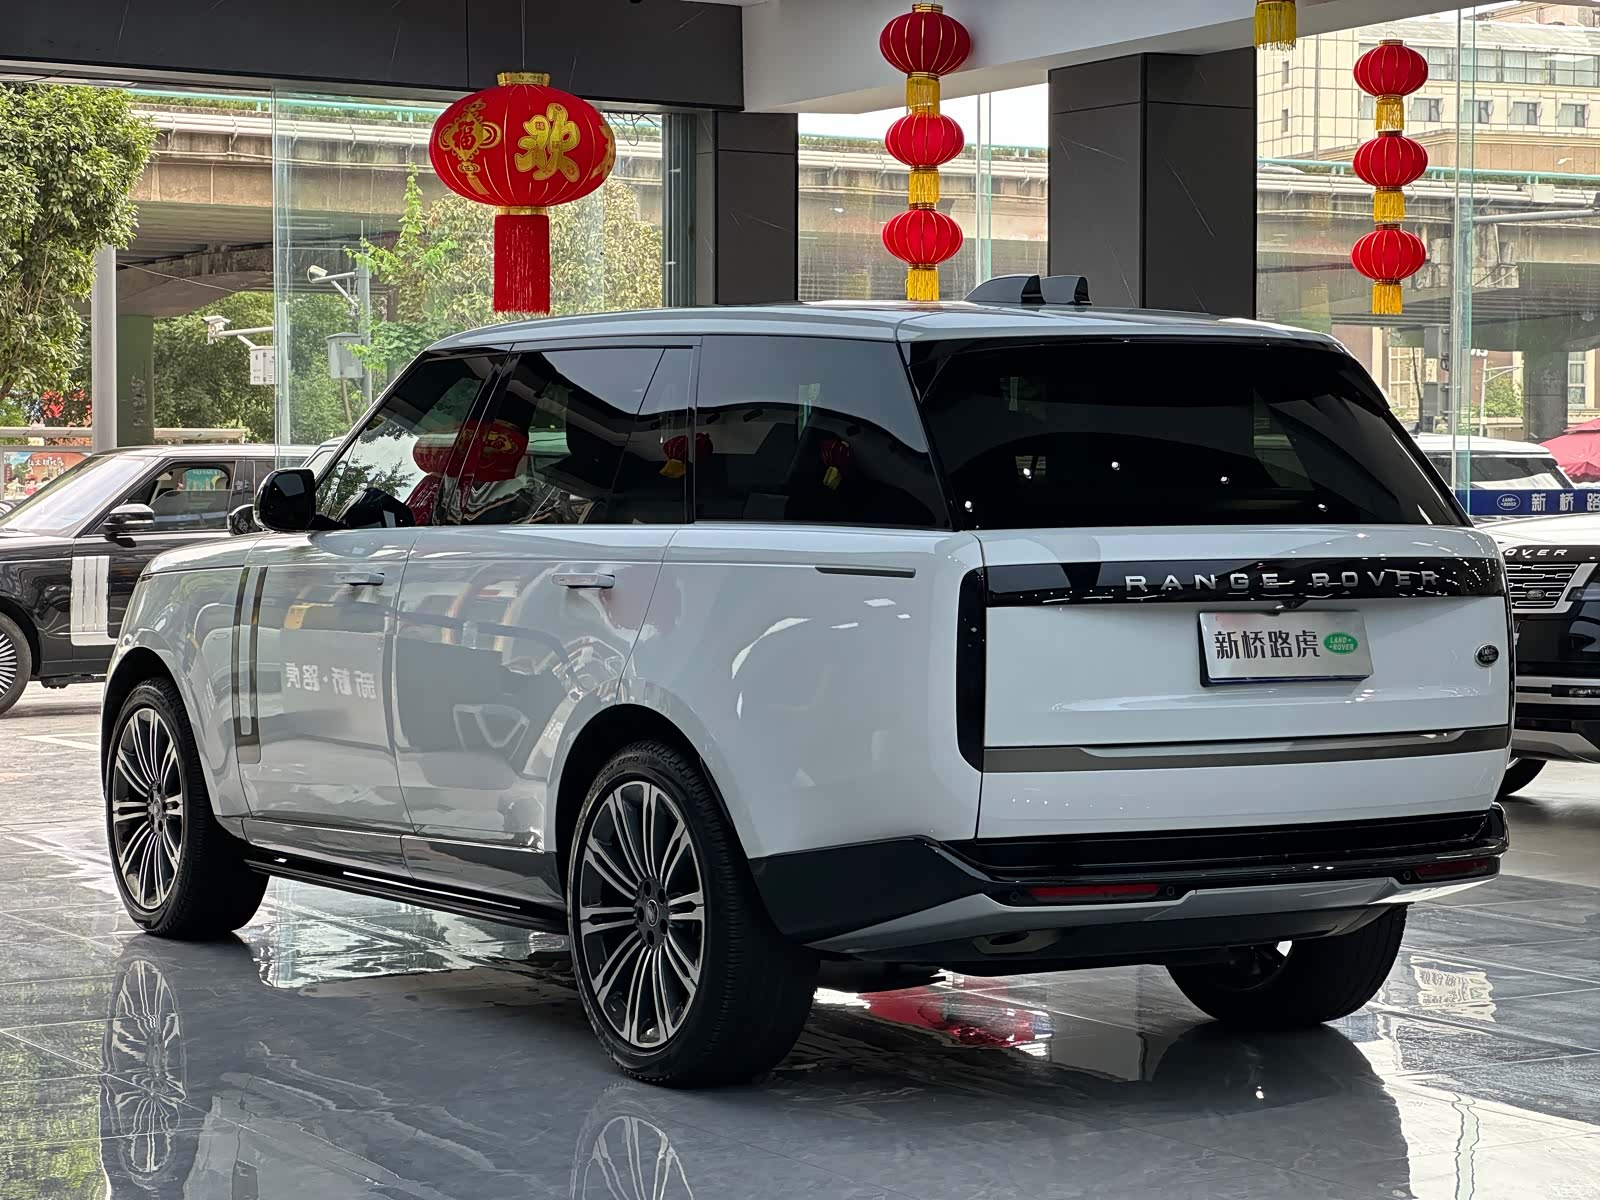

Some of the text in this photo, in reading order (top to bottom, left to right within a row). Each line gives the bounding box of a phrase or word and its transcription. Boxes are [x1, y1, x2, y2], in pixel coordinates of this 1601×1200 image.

[452, 121, 476, 151] 福
[1125, 570, 1440, 591] RANGE ROVER
[1213, 630, 1321, 660] 新桥路虎
[1329, 636, 1347, 644] LAND
[1332, 643, 1354, 651] ROVER
